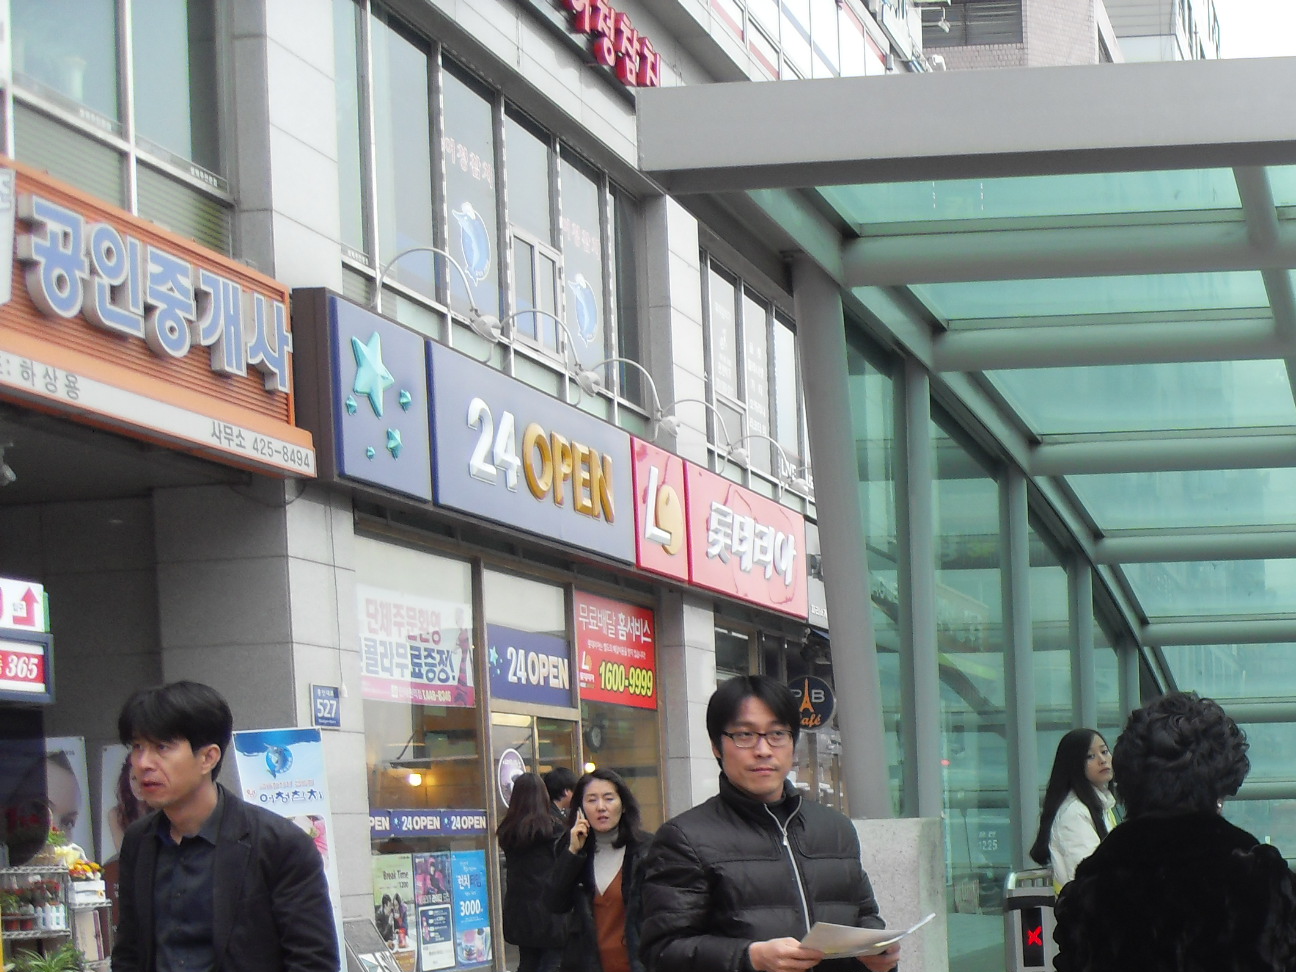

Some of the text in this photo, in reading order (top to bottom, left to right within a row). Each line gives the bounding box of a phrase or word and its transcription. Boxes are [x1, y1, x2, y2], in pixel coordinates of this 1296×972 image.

[30, 194, 293, 394] 공인중개사
[211, 420, 311, 469] 사무소 425-8494
[706, 500, 798, 587] 롯데리아
[579, 603, 652, 644] 무료배달 홈서비스
[6, 654, 38, 679] 365
[599, 660, 653, 697] 1600-9999
[316, 698, 337, 718] 527
[800, 714, 822, 728] afé
